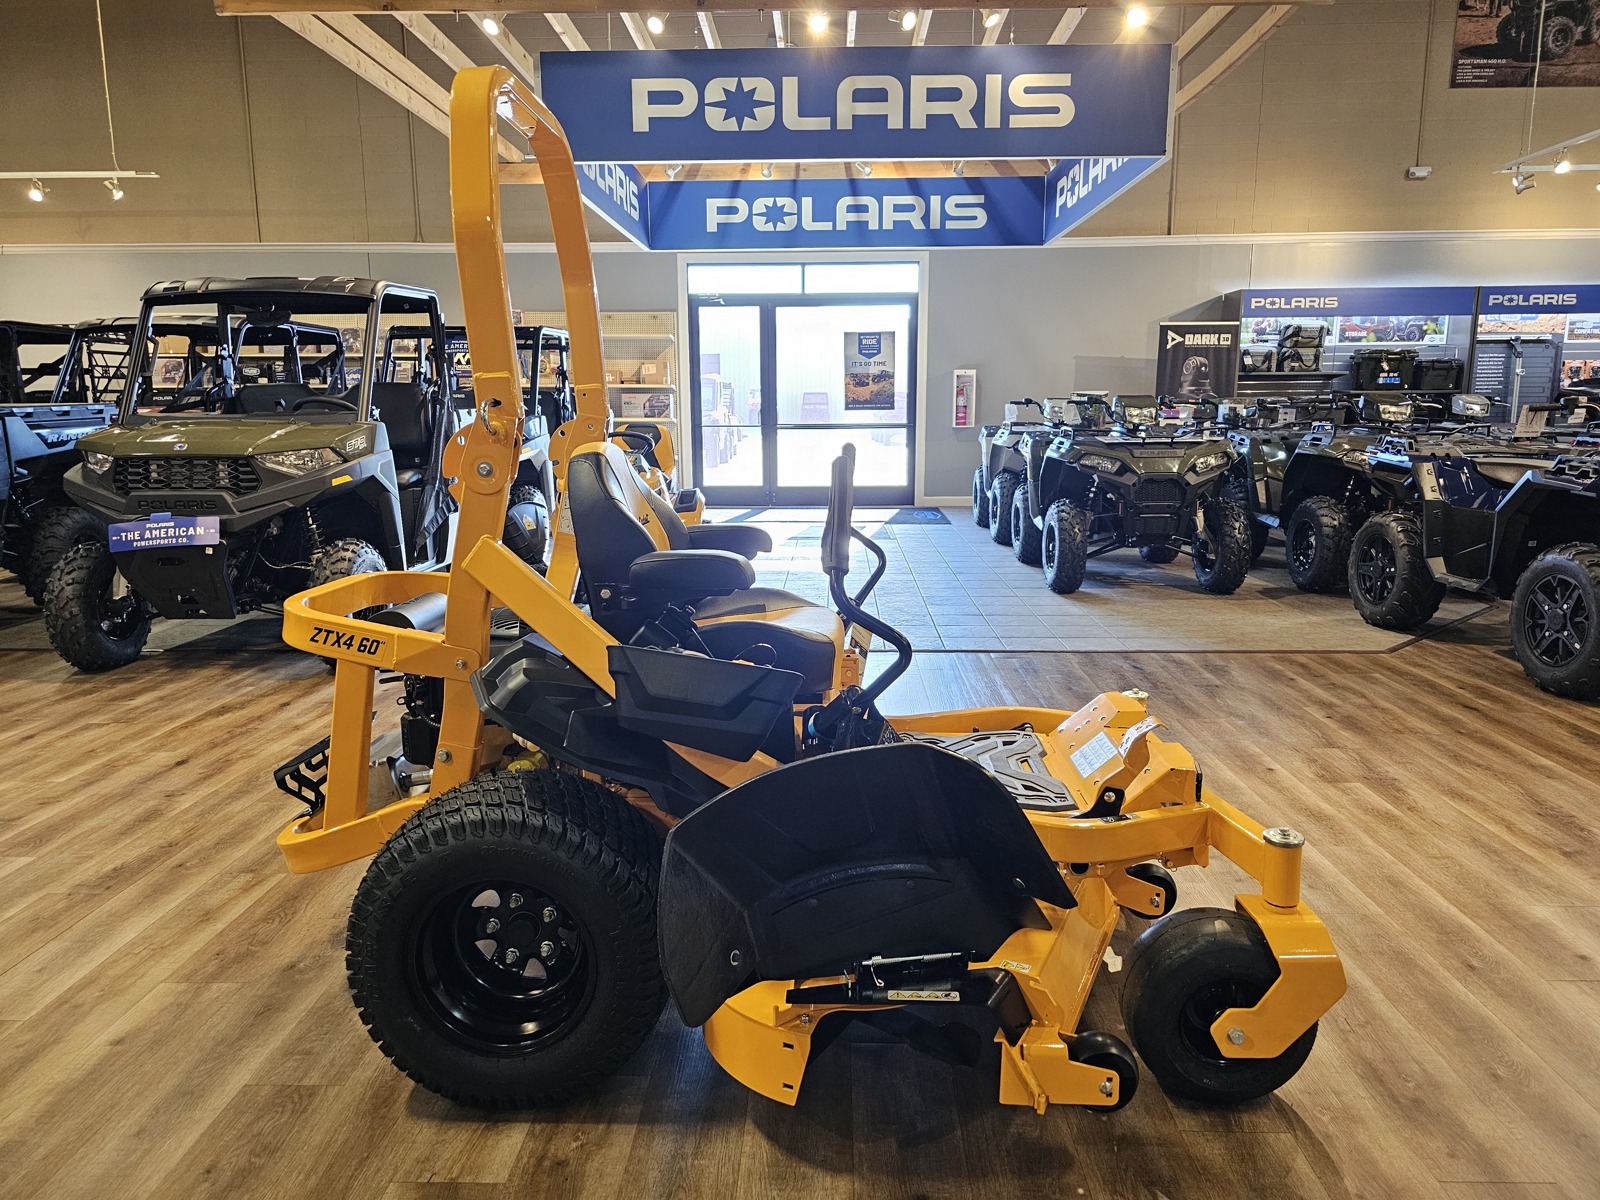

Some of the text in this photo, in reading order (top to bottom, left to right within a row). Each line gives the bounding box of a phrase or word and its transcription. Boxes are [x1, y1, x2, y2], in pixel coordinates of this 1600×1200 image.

[631, 73, 1076, 133] POLARIS
[706, 194, 988, 233] POLARIS
[1251, 297, 1339, 309] POLARIS
[1488, 294, 1577, 306] POLARIS
[1184, 333, 1219, 345] DARK
[138, 499, 218, 511] POLARIS
[145, 521, 175, 529] POLARIS
[120, 526, 205, 541] THE AMERICAN
[133, 537, 177, 548] POWERSPORTS
[309, 626, 387, 656] ZTX4 60"
